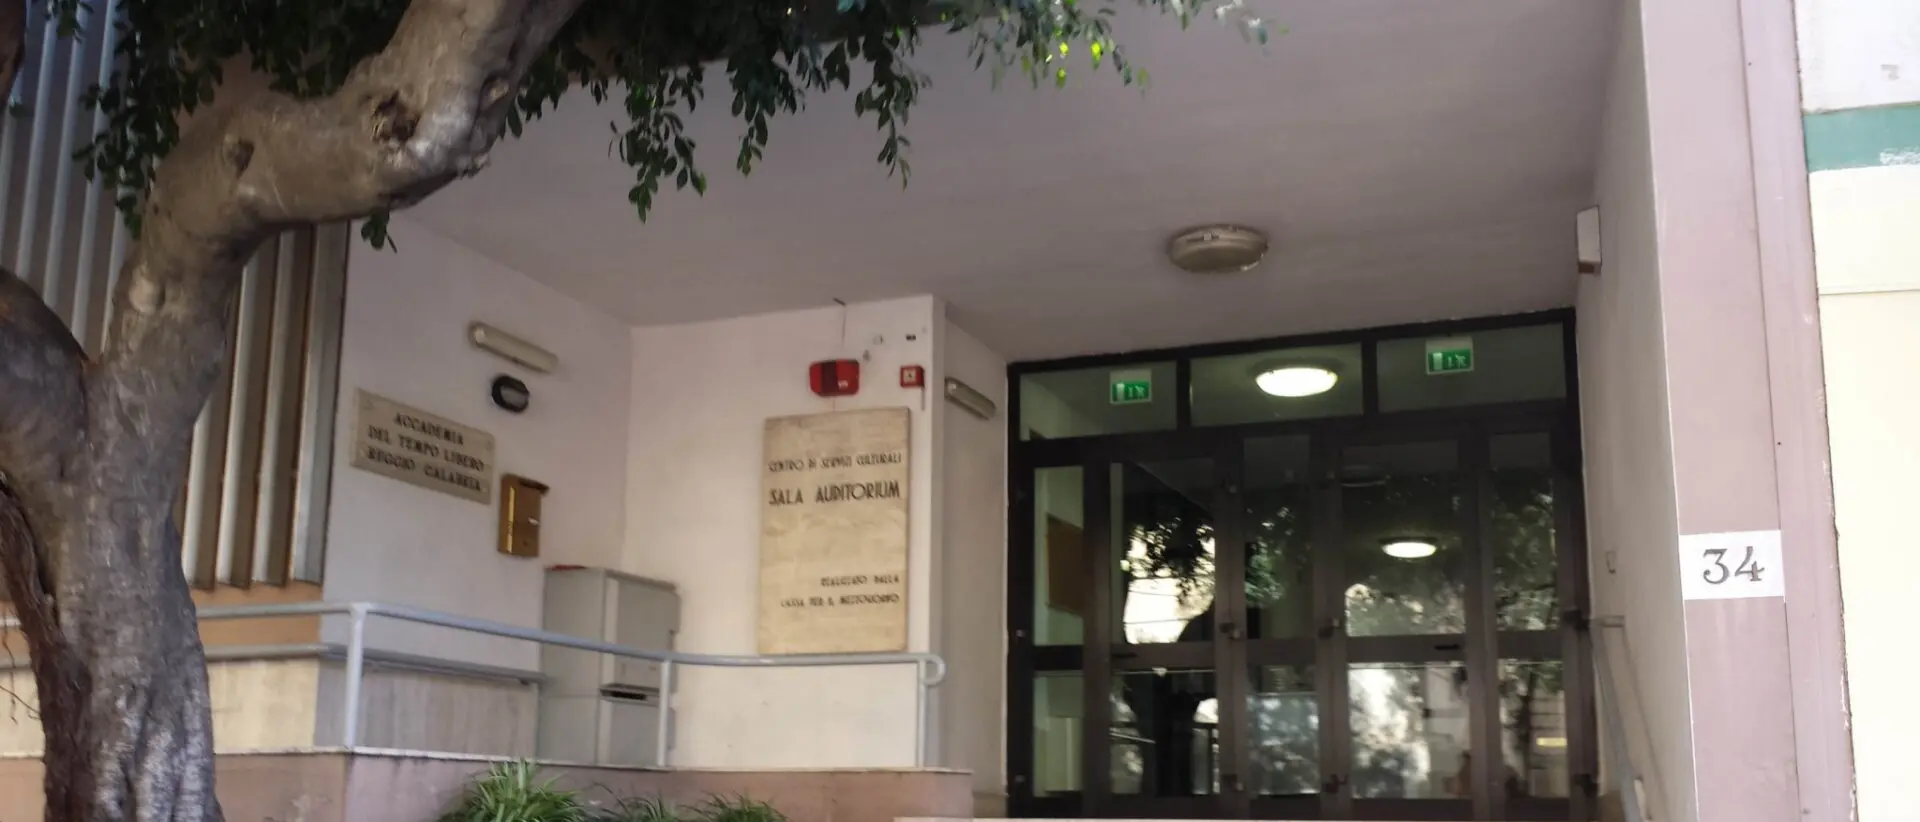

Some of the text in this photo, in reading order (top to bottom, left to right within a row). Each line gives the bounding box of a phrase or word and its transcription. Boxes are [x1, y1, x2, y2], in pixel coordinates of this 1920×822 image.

[394, 412, 464, 445] ACCADEMIA
[367, 425, 485, 472] DEL TEMPO LIBERO
[768, 459, 804, 473] CENTRO
[808, 458, 817, 470] DI
[856, 452, 902, 466] CULTURALI
[367, 446, 481, 491] REGGIO CALABRIA
[769, 480, 900, 505] SALA AUDITORIUM
[1703, 546, 1765, 584] 34
[809, 596, 824, 607] PER
